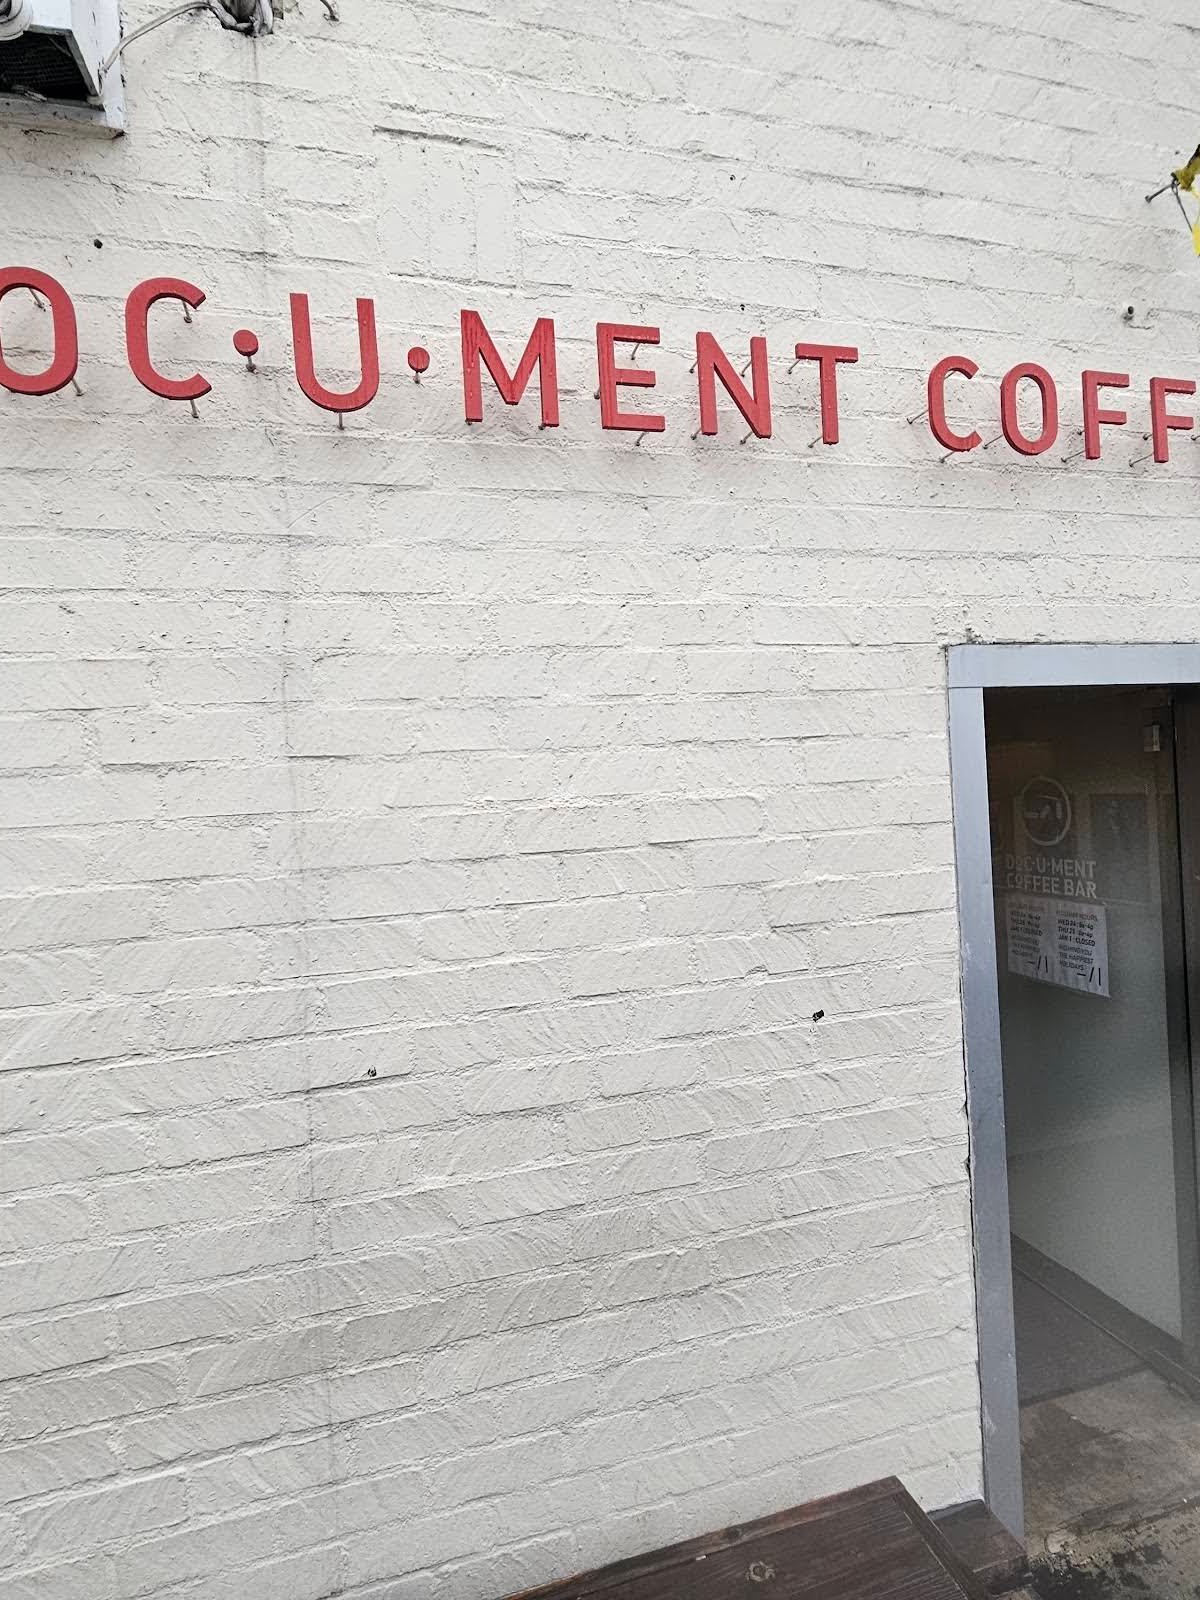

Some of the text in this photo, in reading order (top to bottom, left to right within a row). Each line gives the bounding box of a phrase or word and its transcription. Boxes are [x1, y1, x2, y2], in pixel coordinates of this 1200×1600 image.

[927, 356, 1197, 463] COFF
[1007, 872, 1097, 899] COFFEE BAR
[1075, 937, 1096, 947] CLOSED
